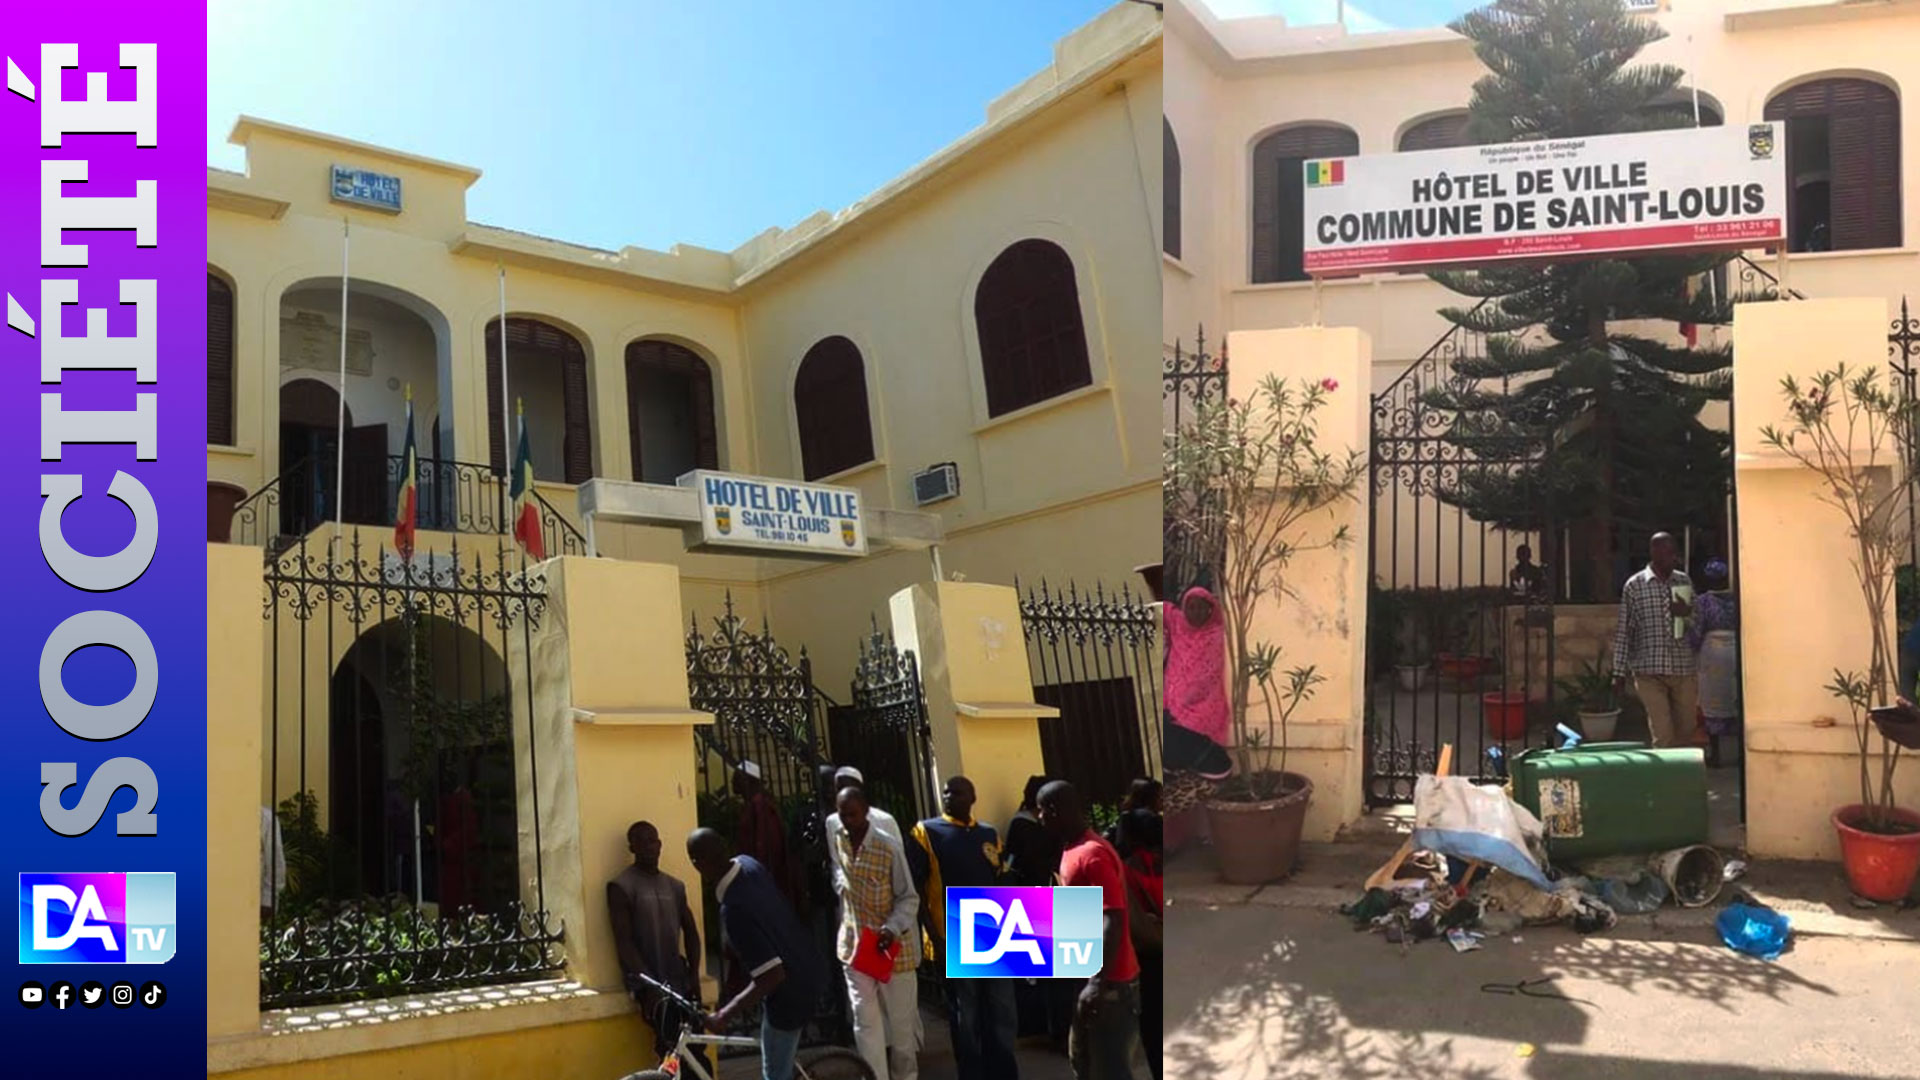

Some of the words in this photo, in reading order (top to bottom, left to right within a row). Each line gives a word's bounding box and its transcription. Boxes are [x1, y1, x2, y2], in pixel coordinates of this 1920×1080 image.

[1413, 171, 1506, 203] HÔTEL
[1516, 169, 1553, 196] DE
[1562, 161, 1647, 191] VILLE
[1317, 203, 1482, 245] COMMUNE
[1493, 200, 1536, 232] DE
[1547, 183, 1765, 228] SAINT-LOUIS
[705, 478, 775, 511] HOTEL
[776, 486, 802, 514] DE
[804, 490, 858, 520] VILLE
